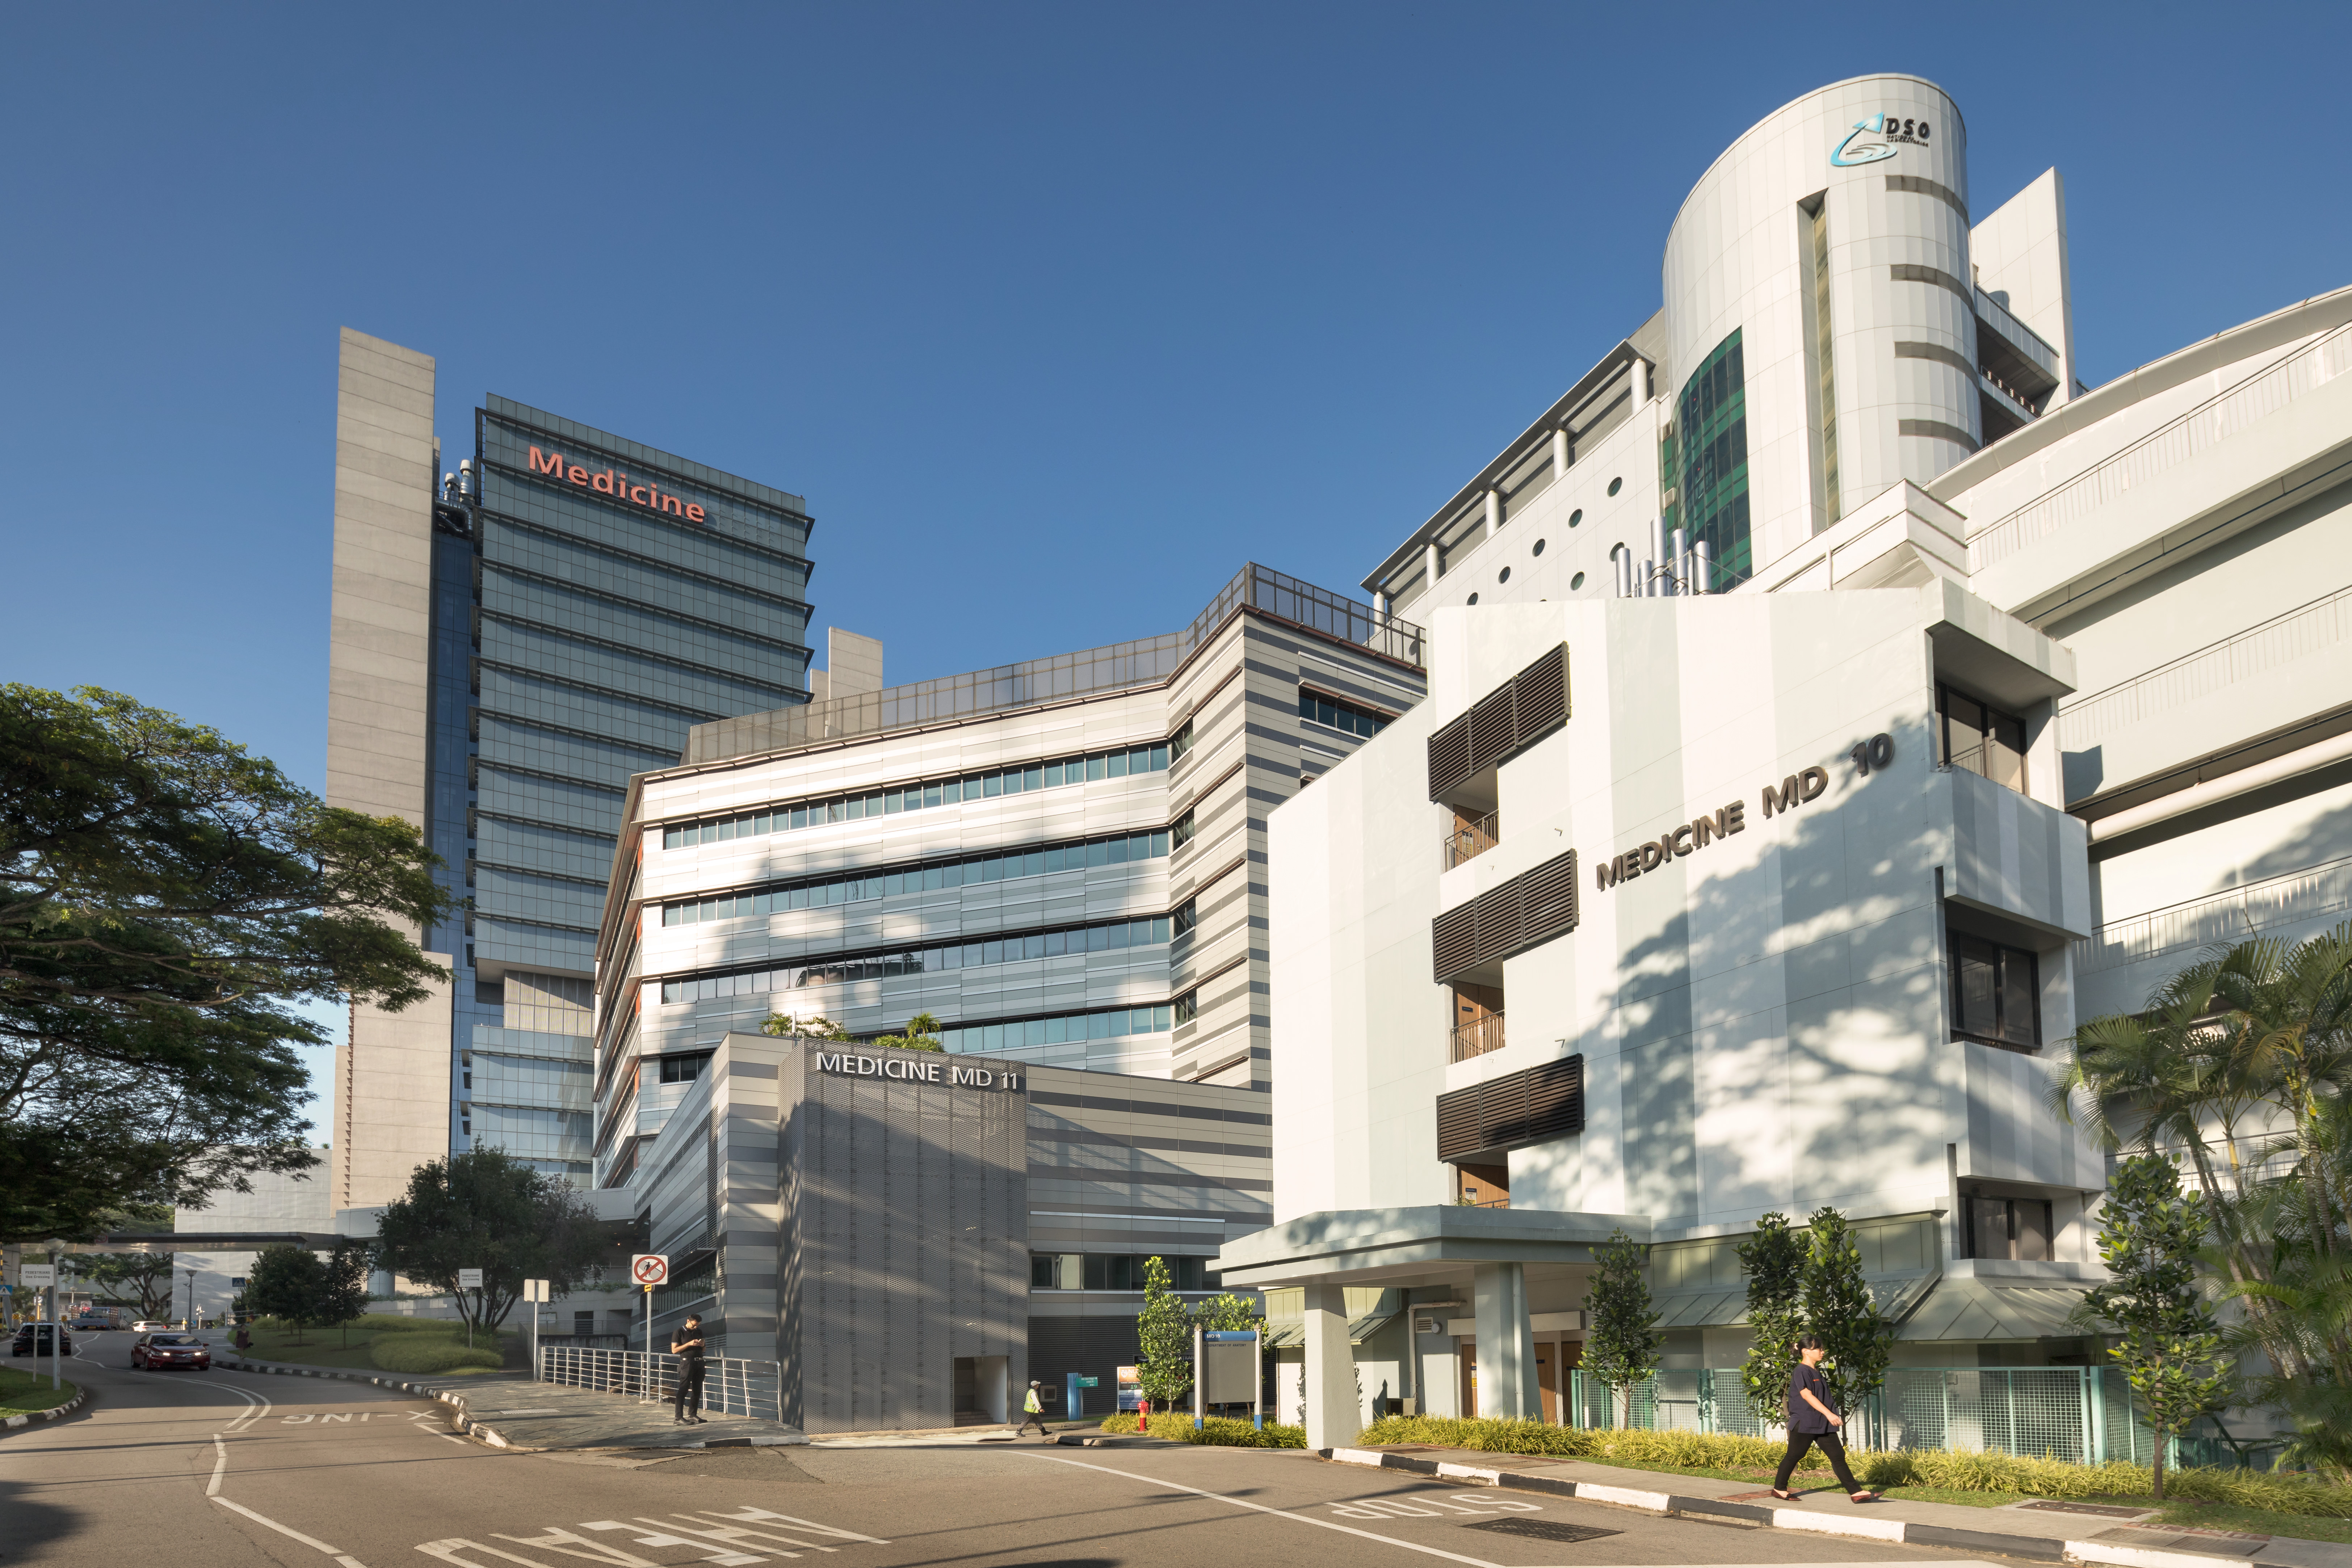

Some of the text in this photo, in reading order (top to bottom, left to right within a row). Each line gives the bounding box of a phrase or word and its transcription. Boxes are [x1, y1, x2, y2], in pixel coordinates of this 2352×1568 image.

[1886, 118, 1930, 139] DSO
[529, 446, 705, 522] Medicine
[1596, 733, 1894, 892] MEDICINE MD 10
[816, 1051, 1017, 1089] MEDICINE MD 11
[280, 1410, 440, 1424] X-ING
[1323, 1495, 1543, 1518] STOP
